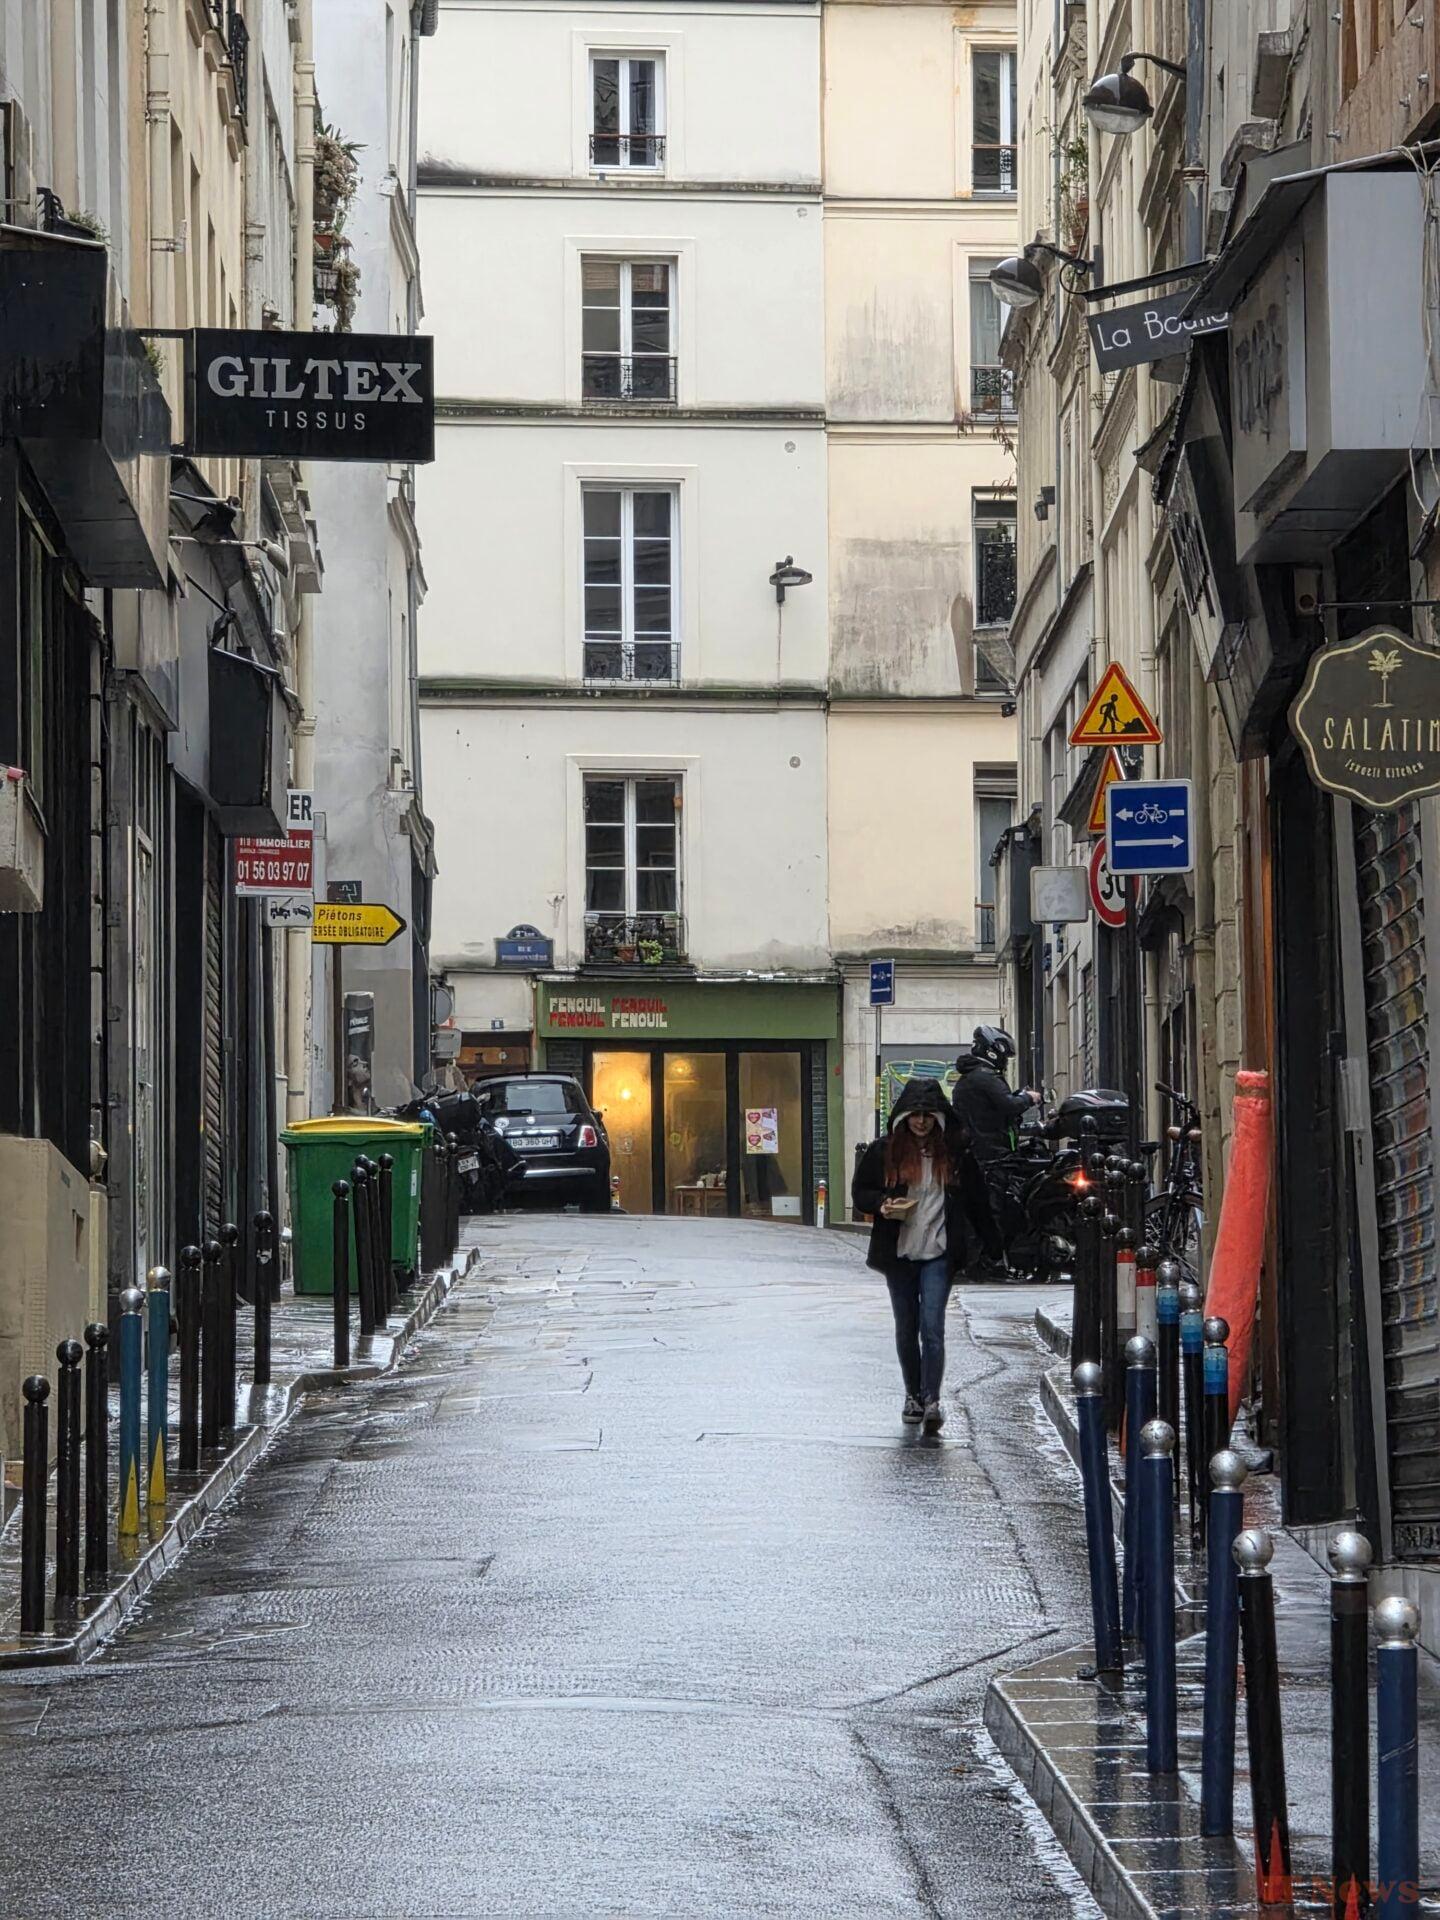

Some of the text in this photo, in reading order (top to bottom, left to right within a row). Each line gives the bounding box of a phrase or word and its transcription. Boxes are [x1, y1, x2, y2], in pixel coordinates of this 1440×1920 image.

[1097, 323, 1132, 351] La
[207, 356, 424, 404] GILTEX
[266, 409, 368, 431] TISSUS
[286, 794, 312, 820] ER
[256, 838, 310, 849] IMMOBILIER
[237, 860, 310, 882] 01 56 03 97 07
[317, 909, 362, 921] Piétons
[338, 926, 385, 938] OBLIGATOIRE
[549, 997, 605, 1012] FENOUIL
[611, 1012, 668, 1028] FENOUIL
